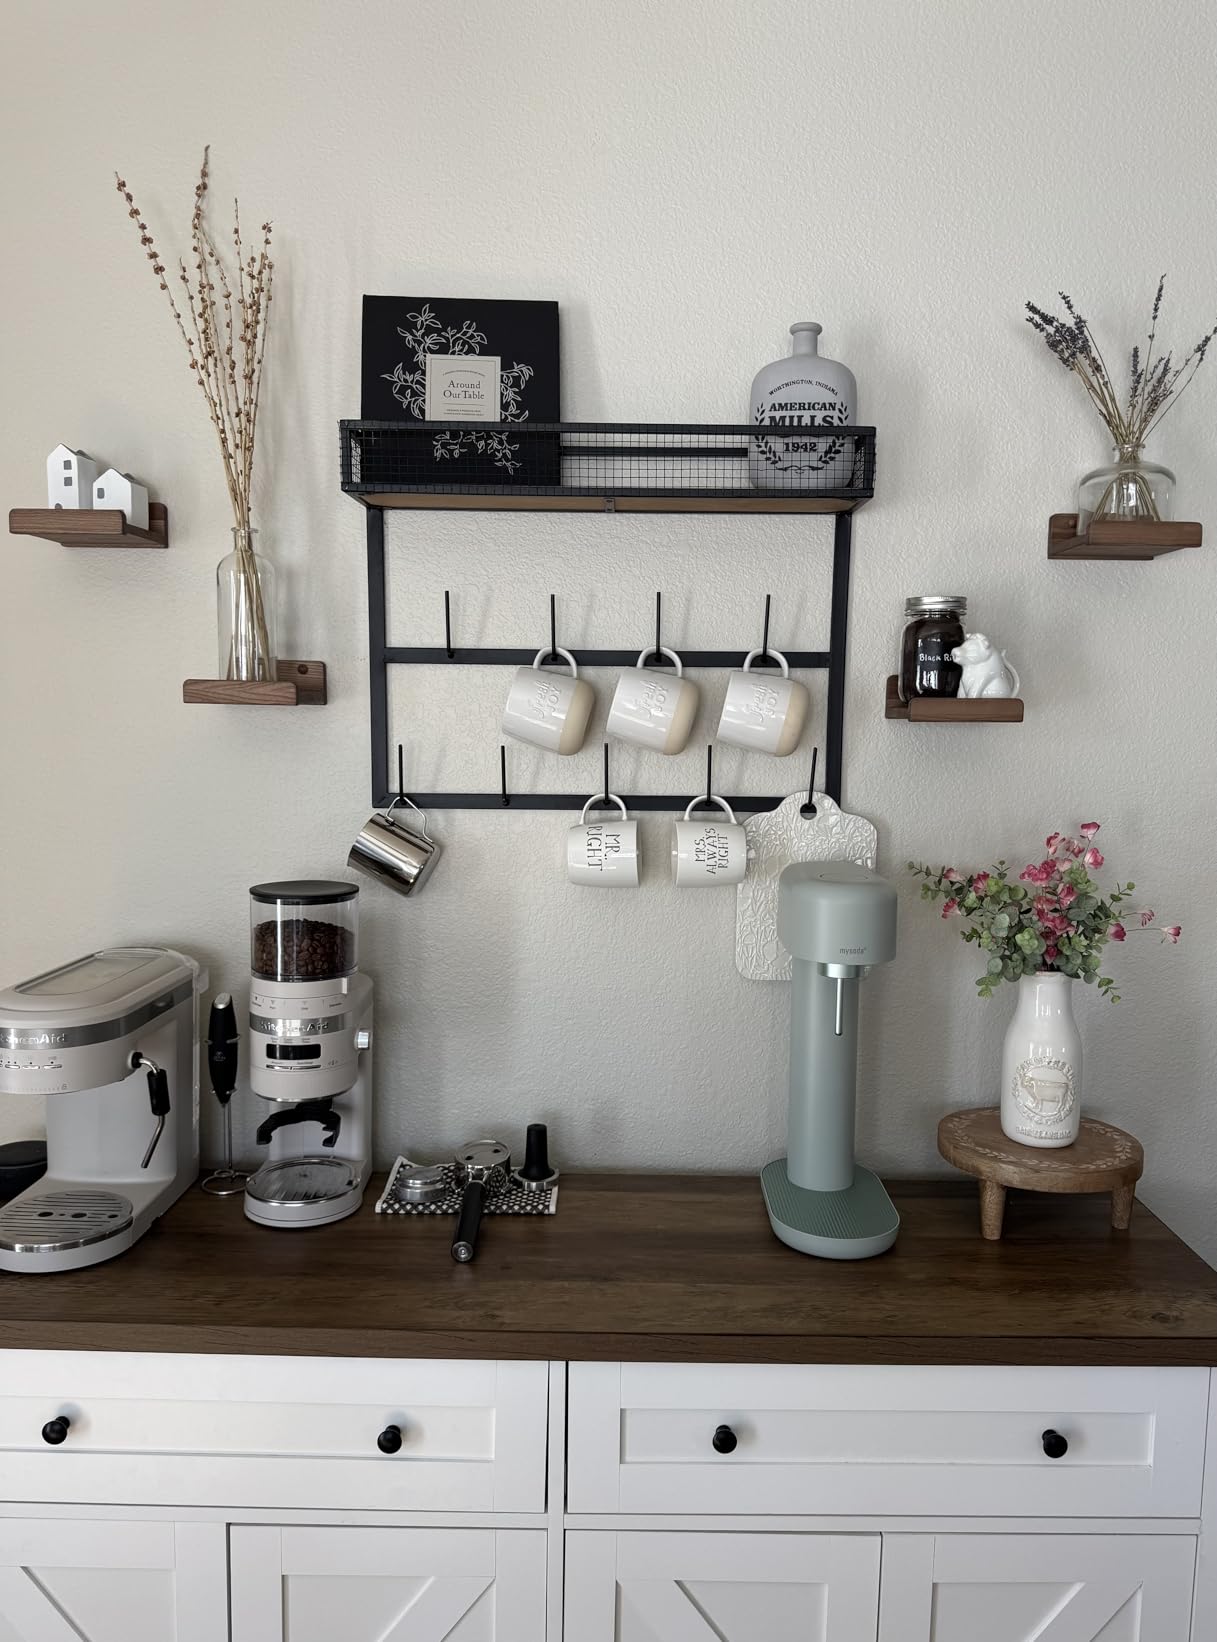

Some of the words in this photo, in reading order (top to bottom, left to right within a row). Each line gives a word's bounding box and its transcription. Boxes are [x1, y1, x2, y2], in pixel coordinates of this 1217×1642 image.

[448, 380, 481, 389] Around
[443, 389, 460, 398] Our
[461, 390, 485, 399] Table
[769, 402, 837, 412] AMERICAN
[768, 415, 834, 427] MILLS
[784, 442, 817, 452] 1942
[919, 653, 941, 661] Black
[943, 653, 953, 661] Ri
[587, 825, 603, 871] RIGHT
[705, 827, 717, 874] ALWAYS
[717, 833, 729, 868] RIGHT
